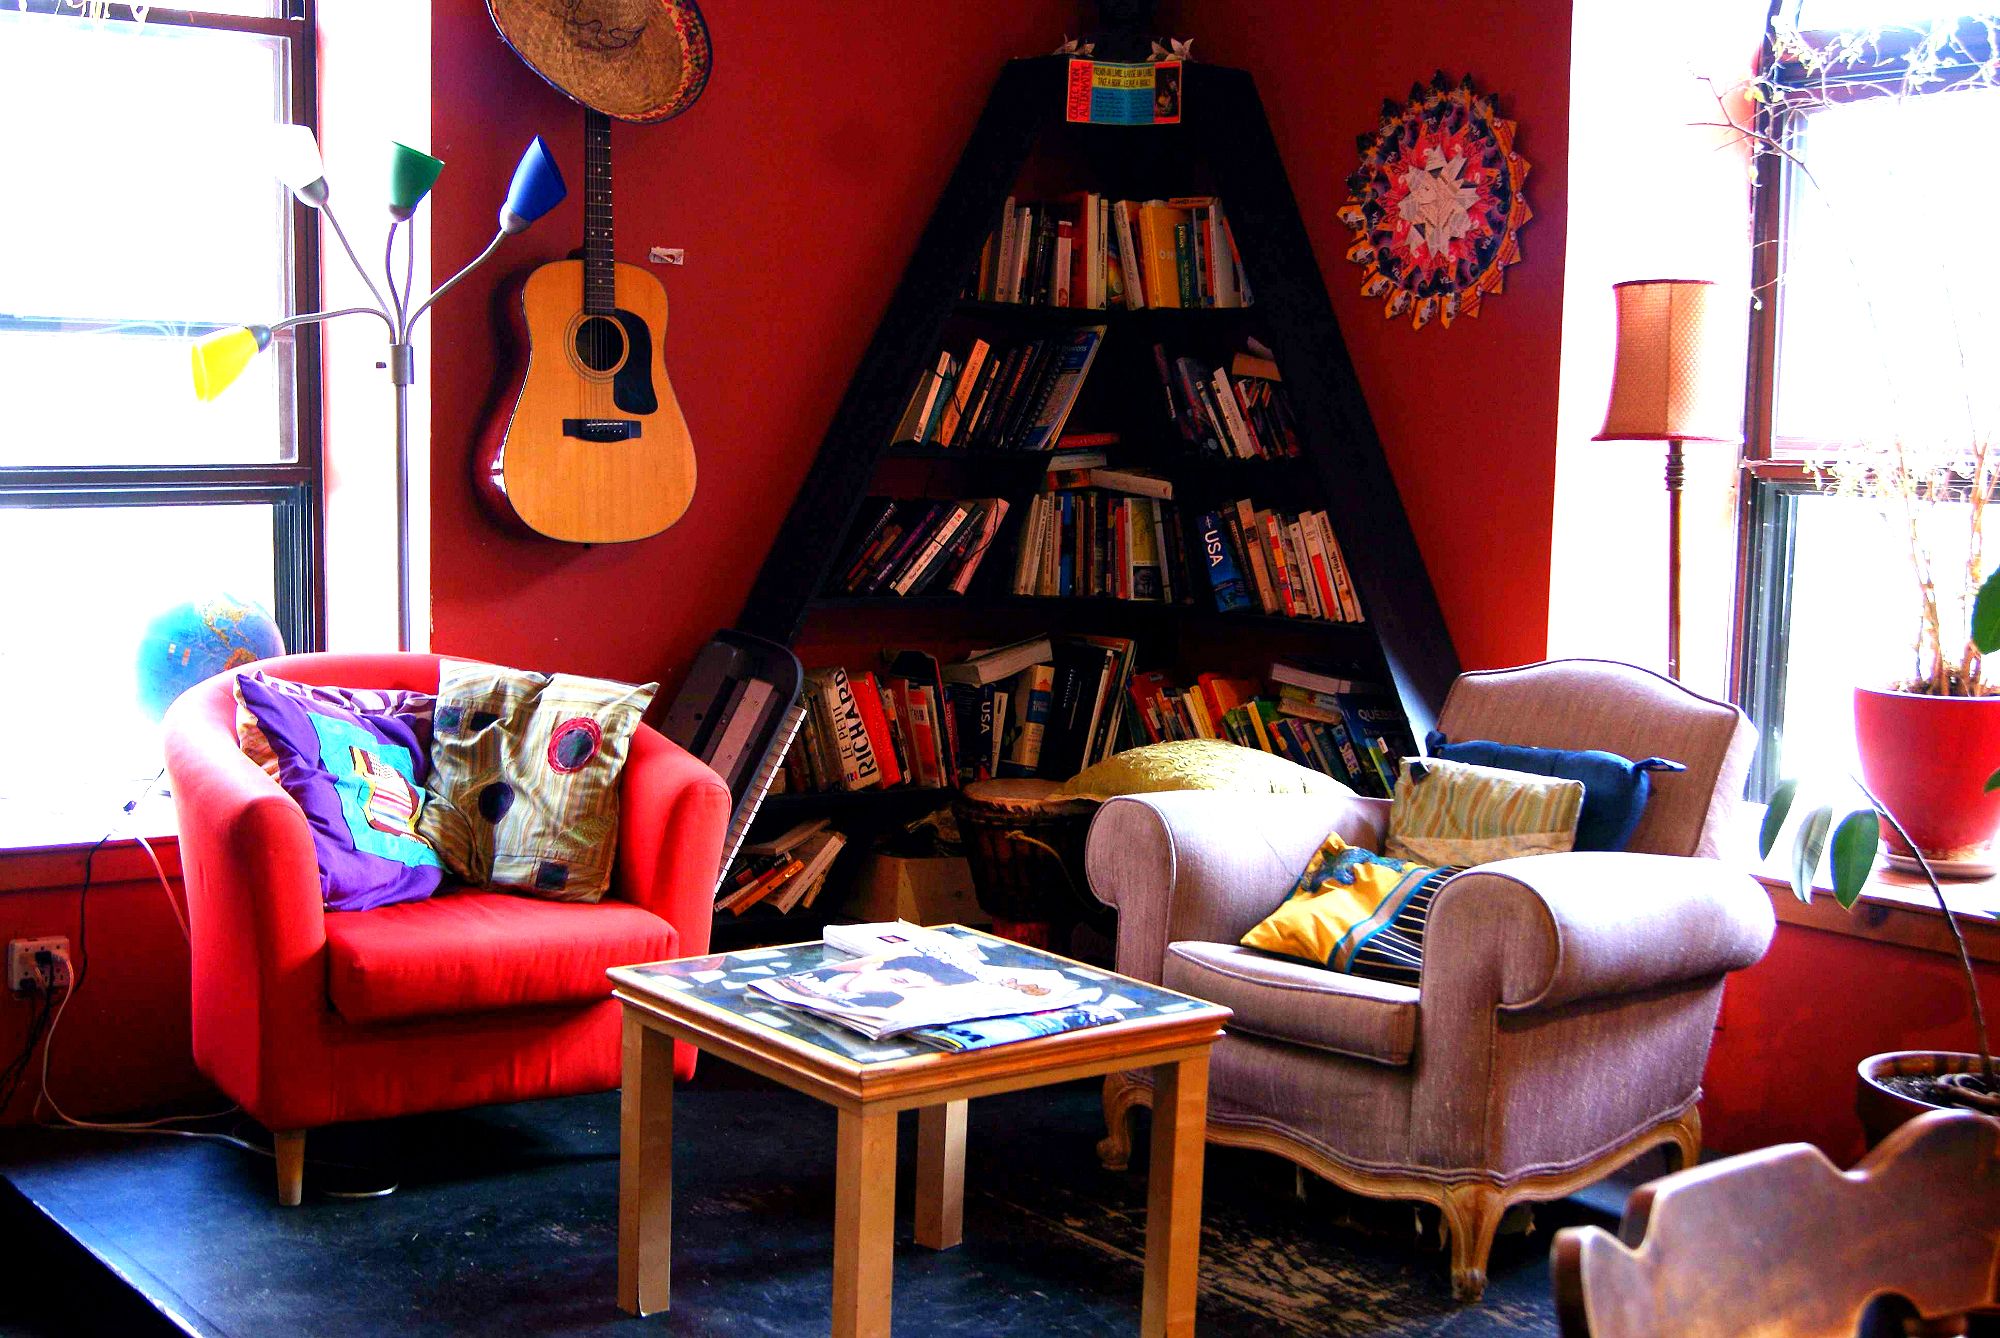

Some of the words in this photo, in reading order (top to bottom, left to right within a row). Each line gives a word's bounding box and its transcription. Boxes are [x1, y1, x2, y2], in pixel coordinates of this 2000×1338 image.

[1204, 529, 1224, 567] USA
[832, 706, 848, 741] PETIT
[834, 669, 878, 779] RICHARD
[980, 701, 991, 734] USA
[842, 744, 853, 759] LE
